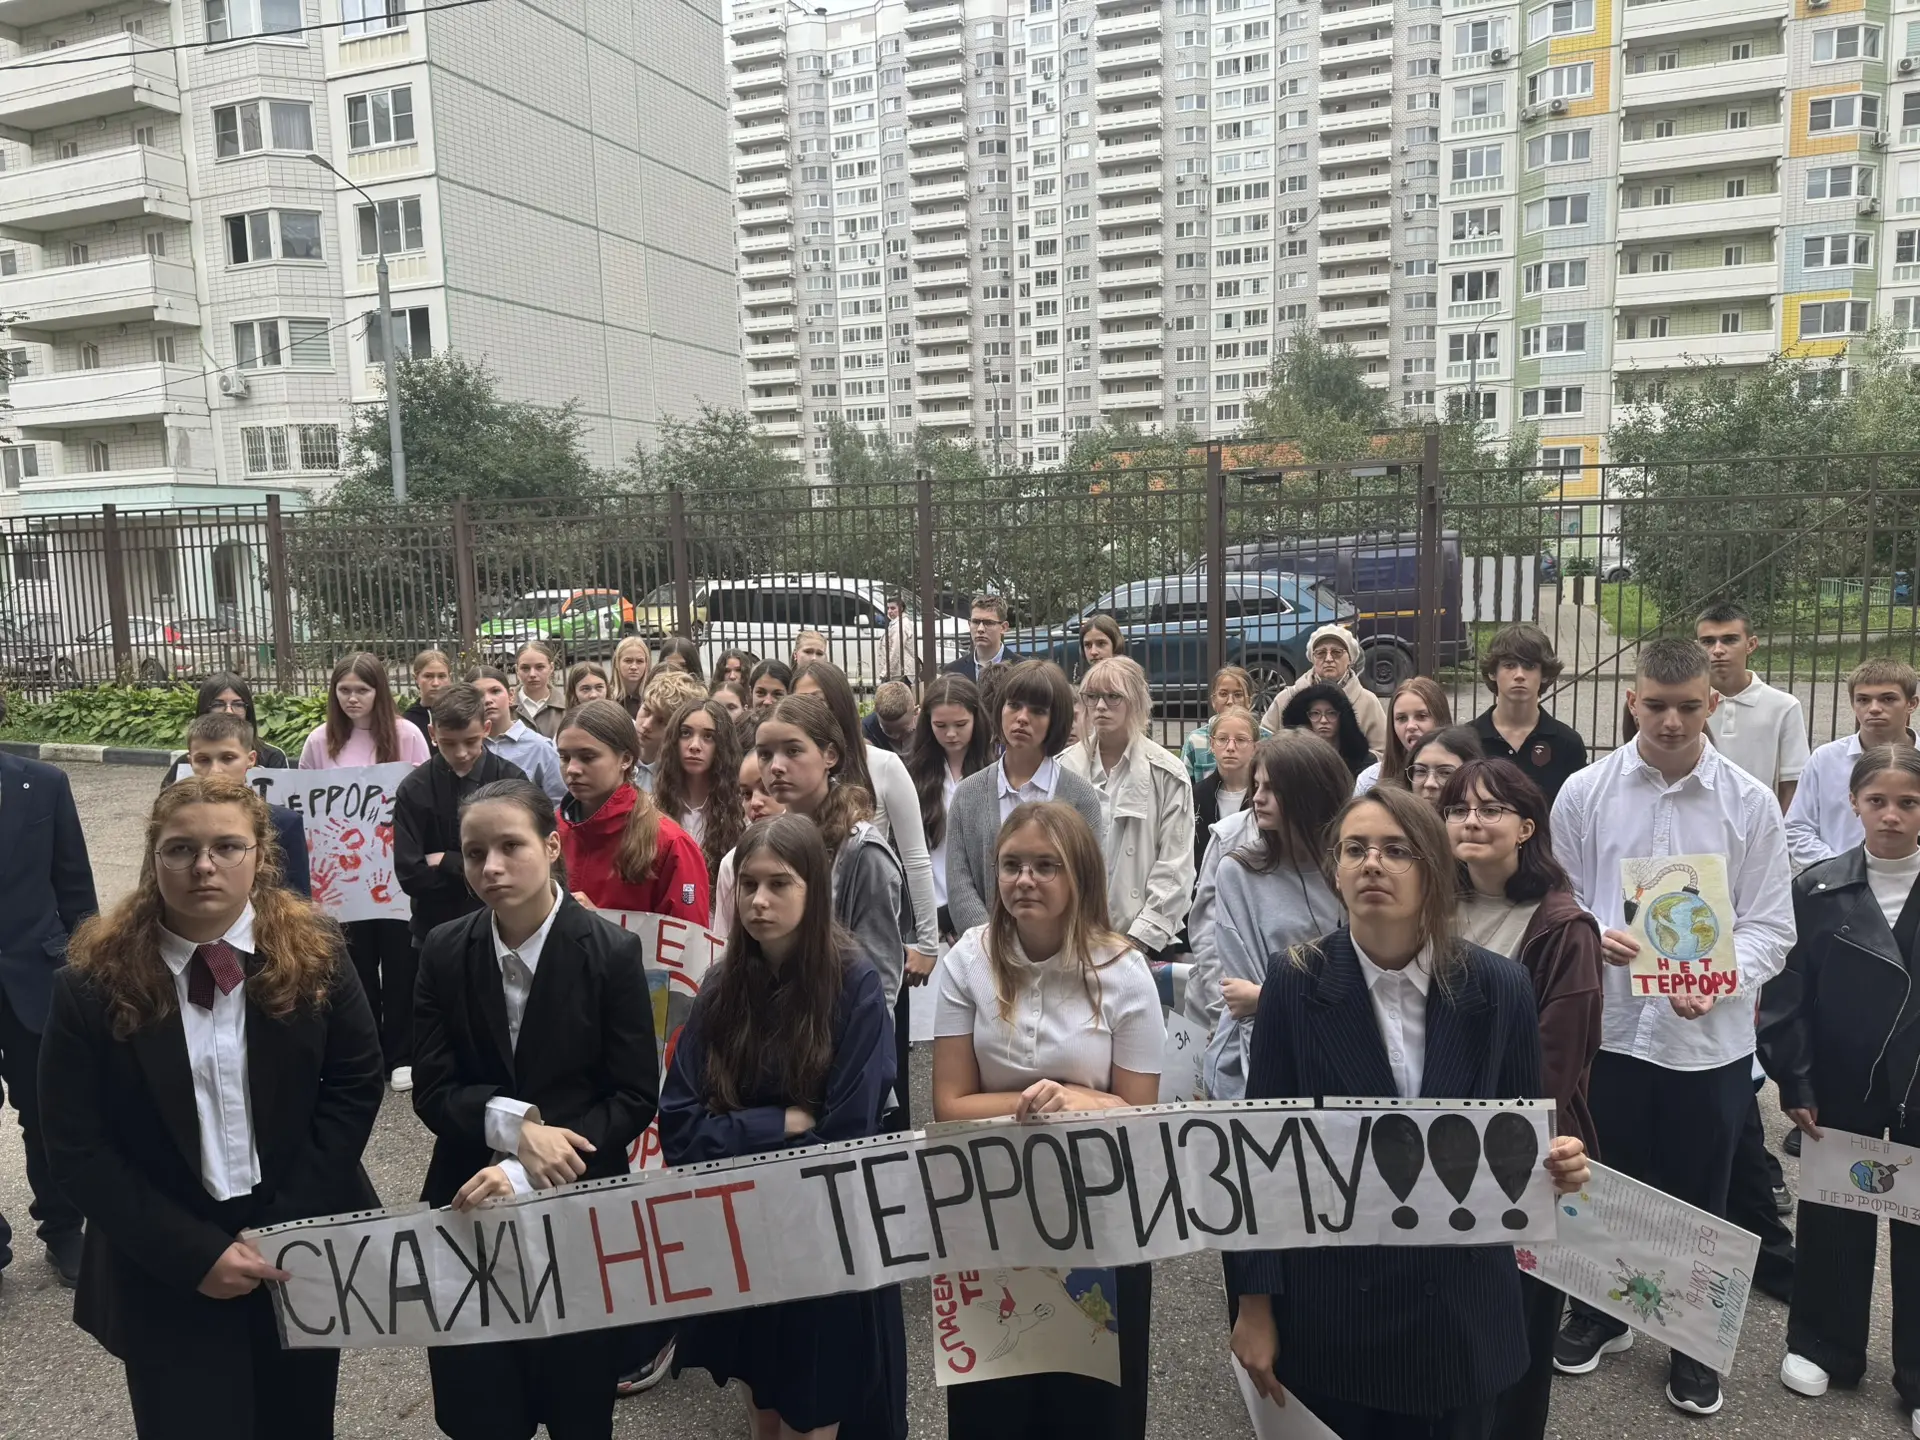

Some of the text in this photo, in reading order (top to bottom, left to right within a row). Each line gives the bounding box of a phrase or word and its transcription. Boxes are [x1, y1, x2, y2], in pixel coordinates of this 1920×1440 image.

[1657, 957, 1713, 973] НЕТ
[1632, 969, 1737, 995] ТЕРРОРУ
[1850, 1136, 1892, 1154] НЕТ
[276, 1213, 565, 1336] СКАЖИ
[589, 1179, 756, 1315] НЕТ
[800, 1113, 1539, 1275] ТЕРРОРИЗМУ!!!
[1685, 1224, 1719, 1311] БЕЗ ВОЙНЫ
[1707, 1270, 1730, 1309] МИР
